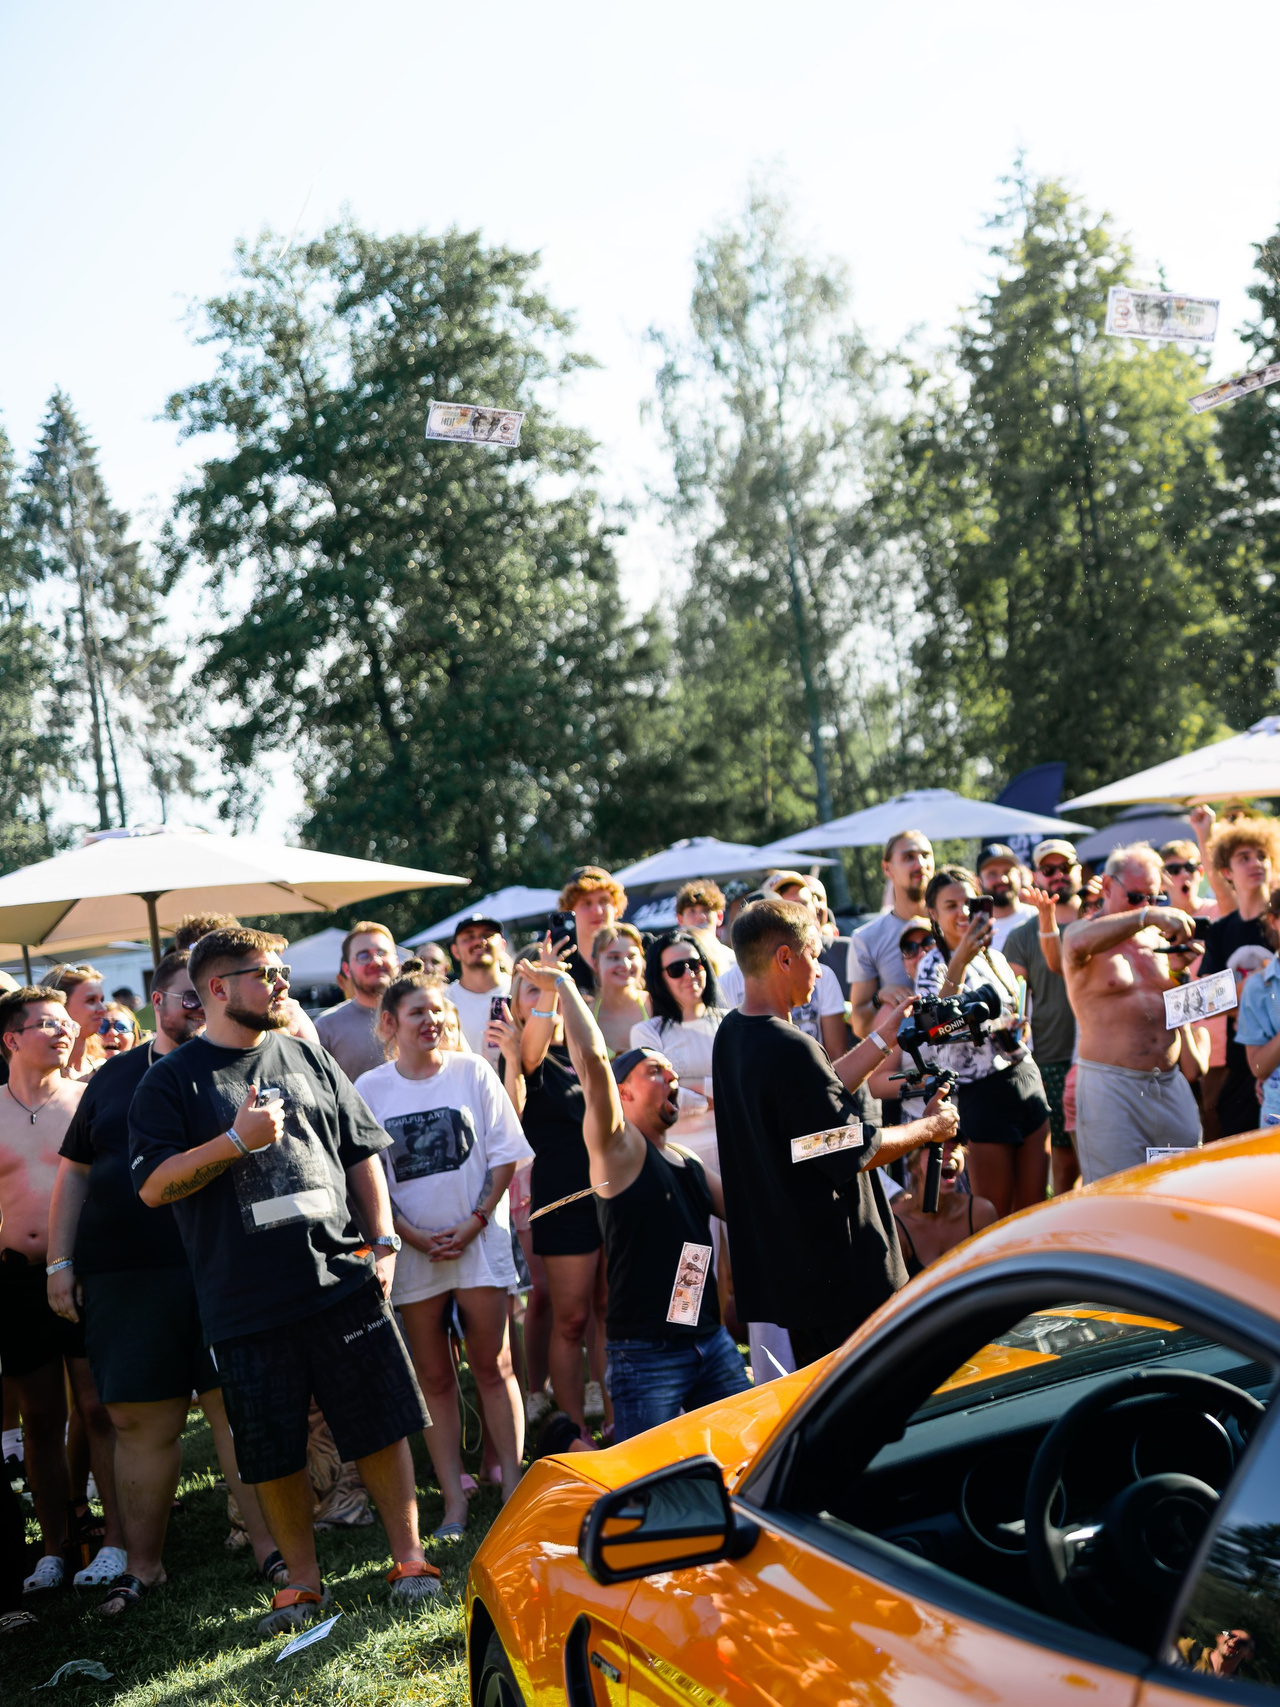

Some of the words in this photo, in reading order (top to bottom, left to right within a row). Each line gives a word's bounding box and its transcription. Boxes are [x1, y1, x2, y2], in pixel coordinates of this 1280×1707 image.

[938, 1017, 966, 1035] RONIN
[385, 1115, 426, 1128] SOULFUL
[427, 1109, 446, 1121] ART
[343, 1329, 364, 1344] Palm
